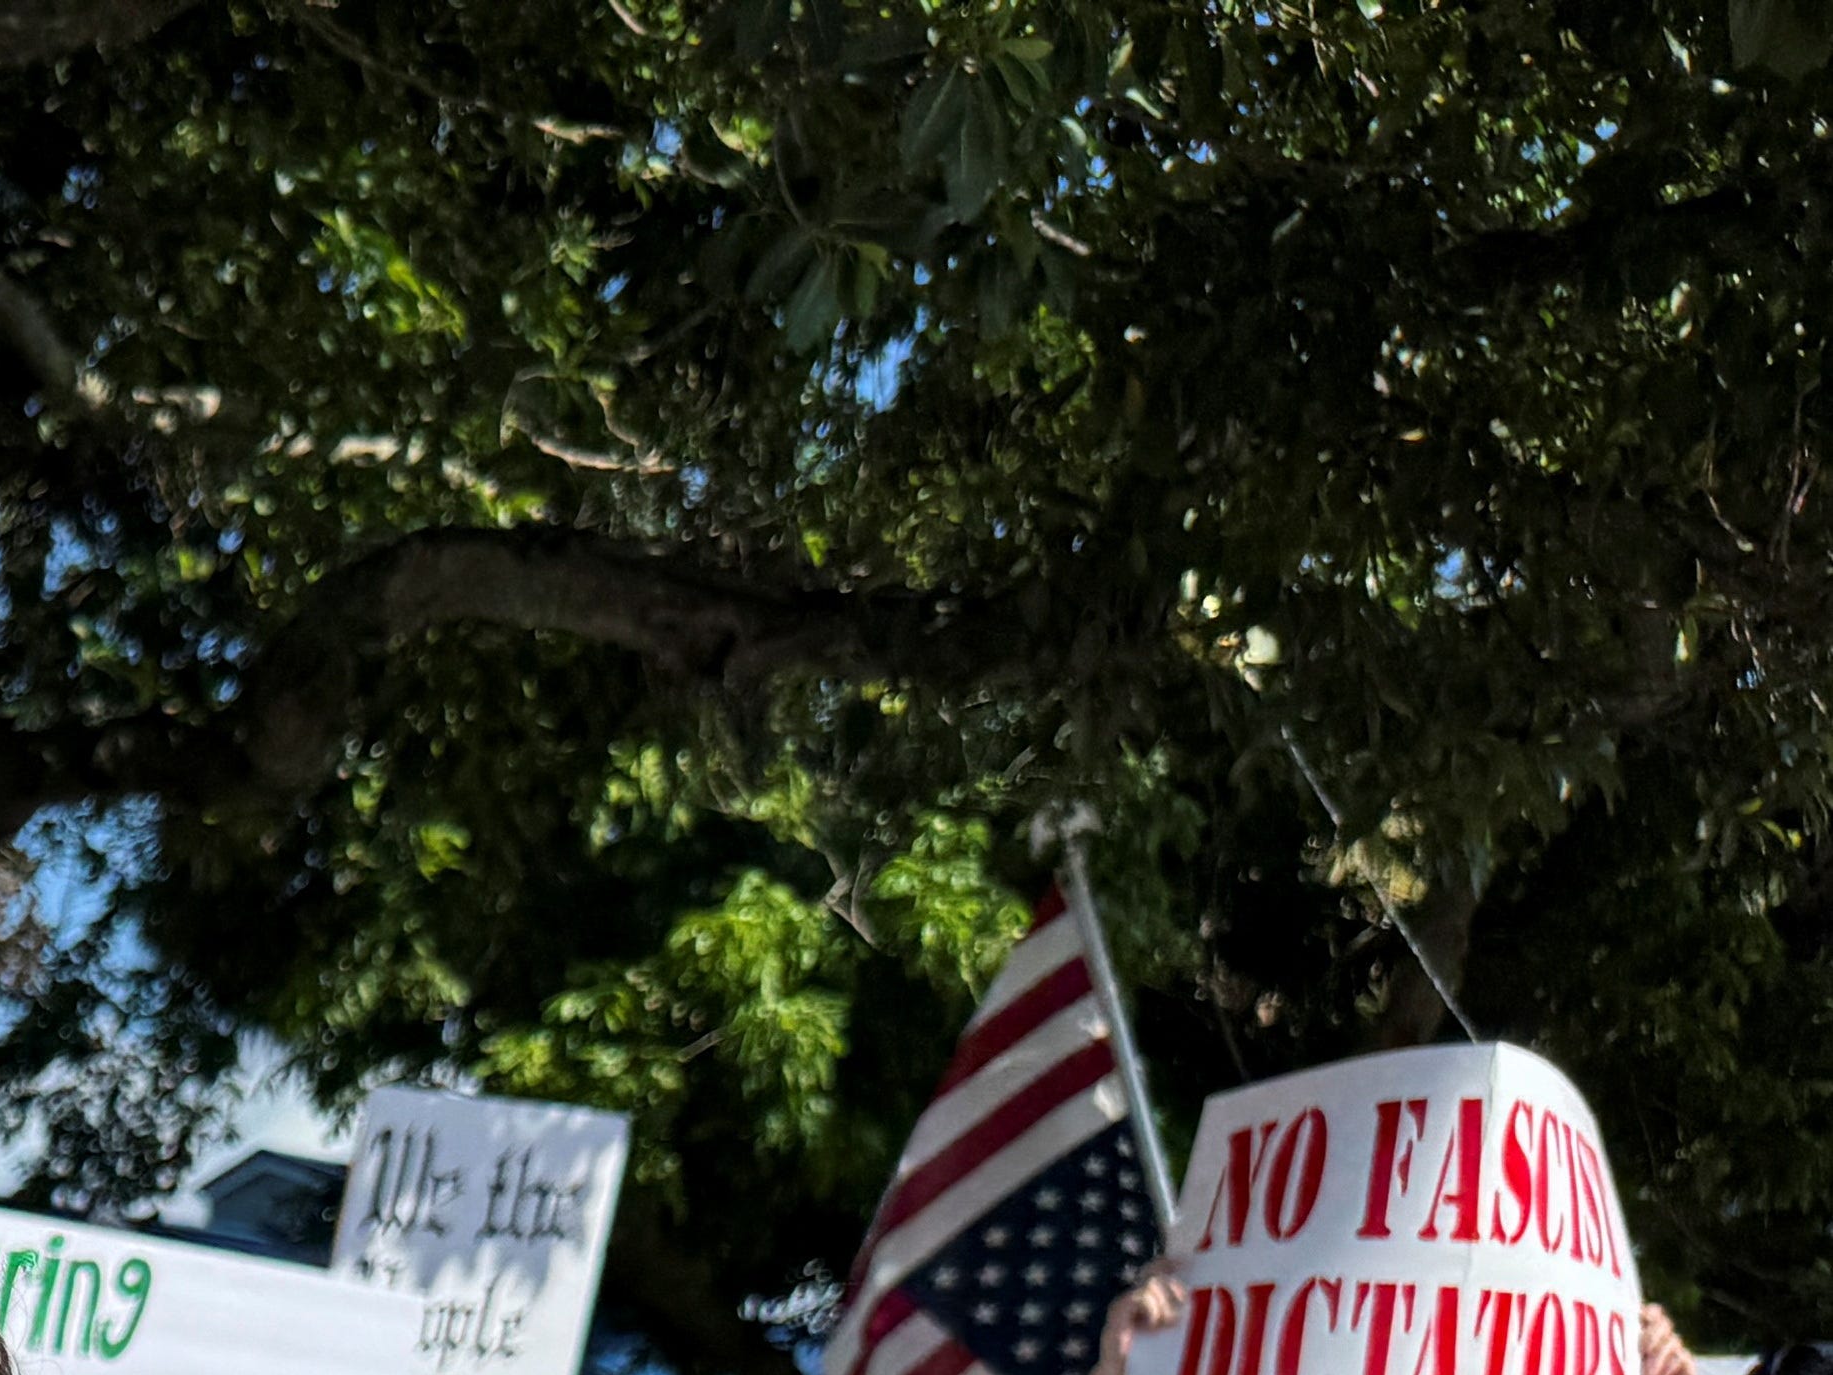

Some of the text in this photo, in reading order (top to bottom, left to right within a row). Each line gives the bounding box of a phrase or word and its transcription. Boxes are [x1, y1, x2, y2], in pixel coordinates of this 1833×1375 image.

[357, 1121, 469, 1240] We
[1195, 1096, 1623, 1281] NO FASCIST
